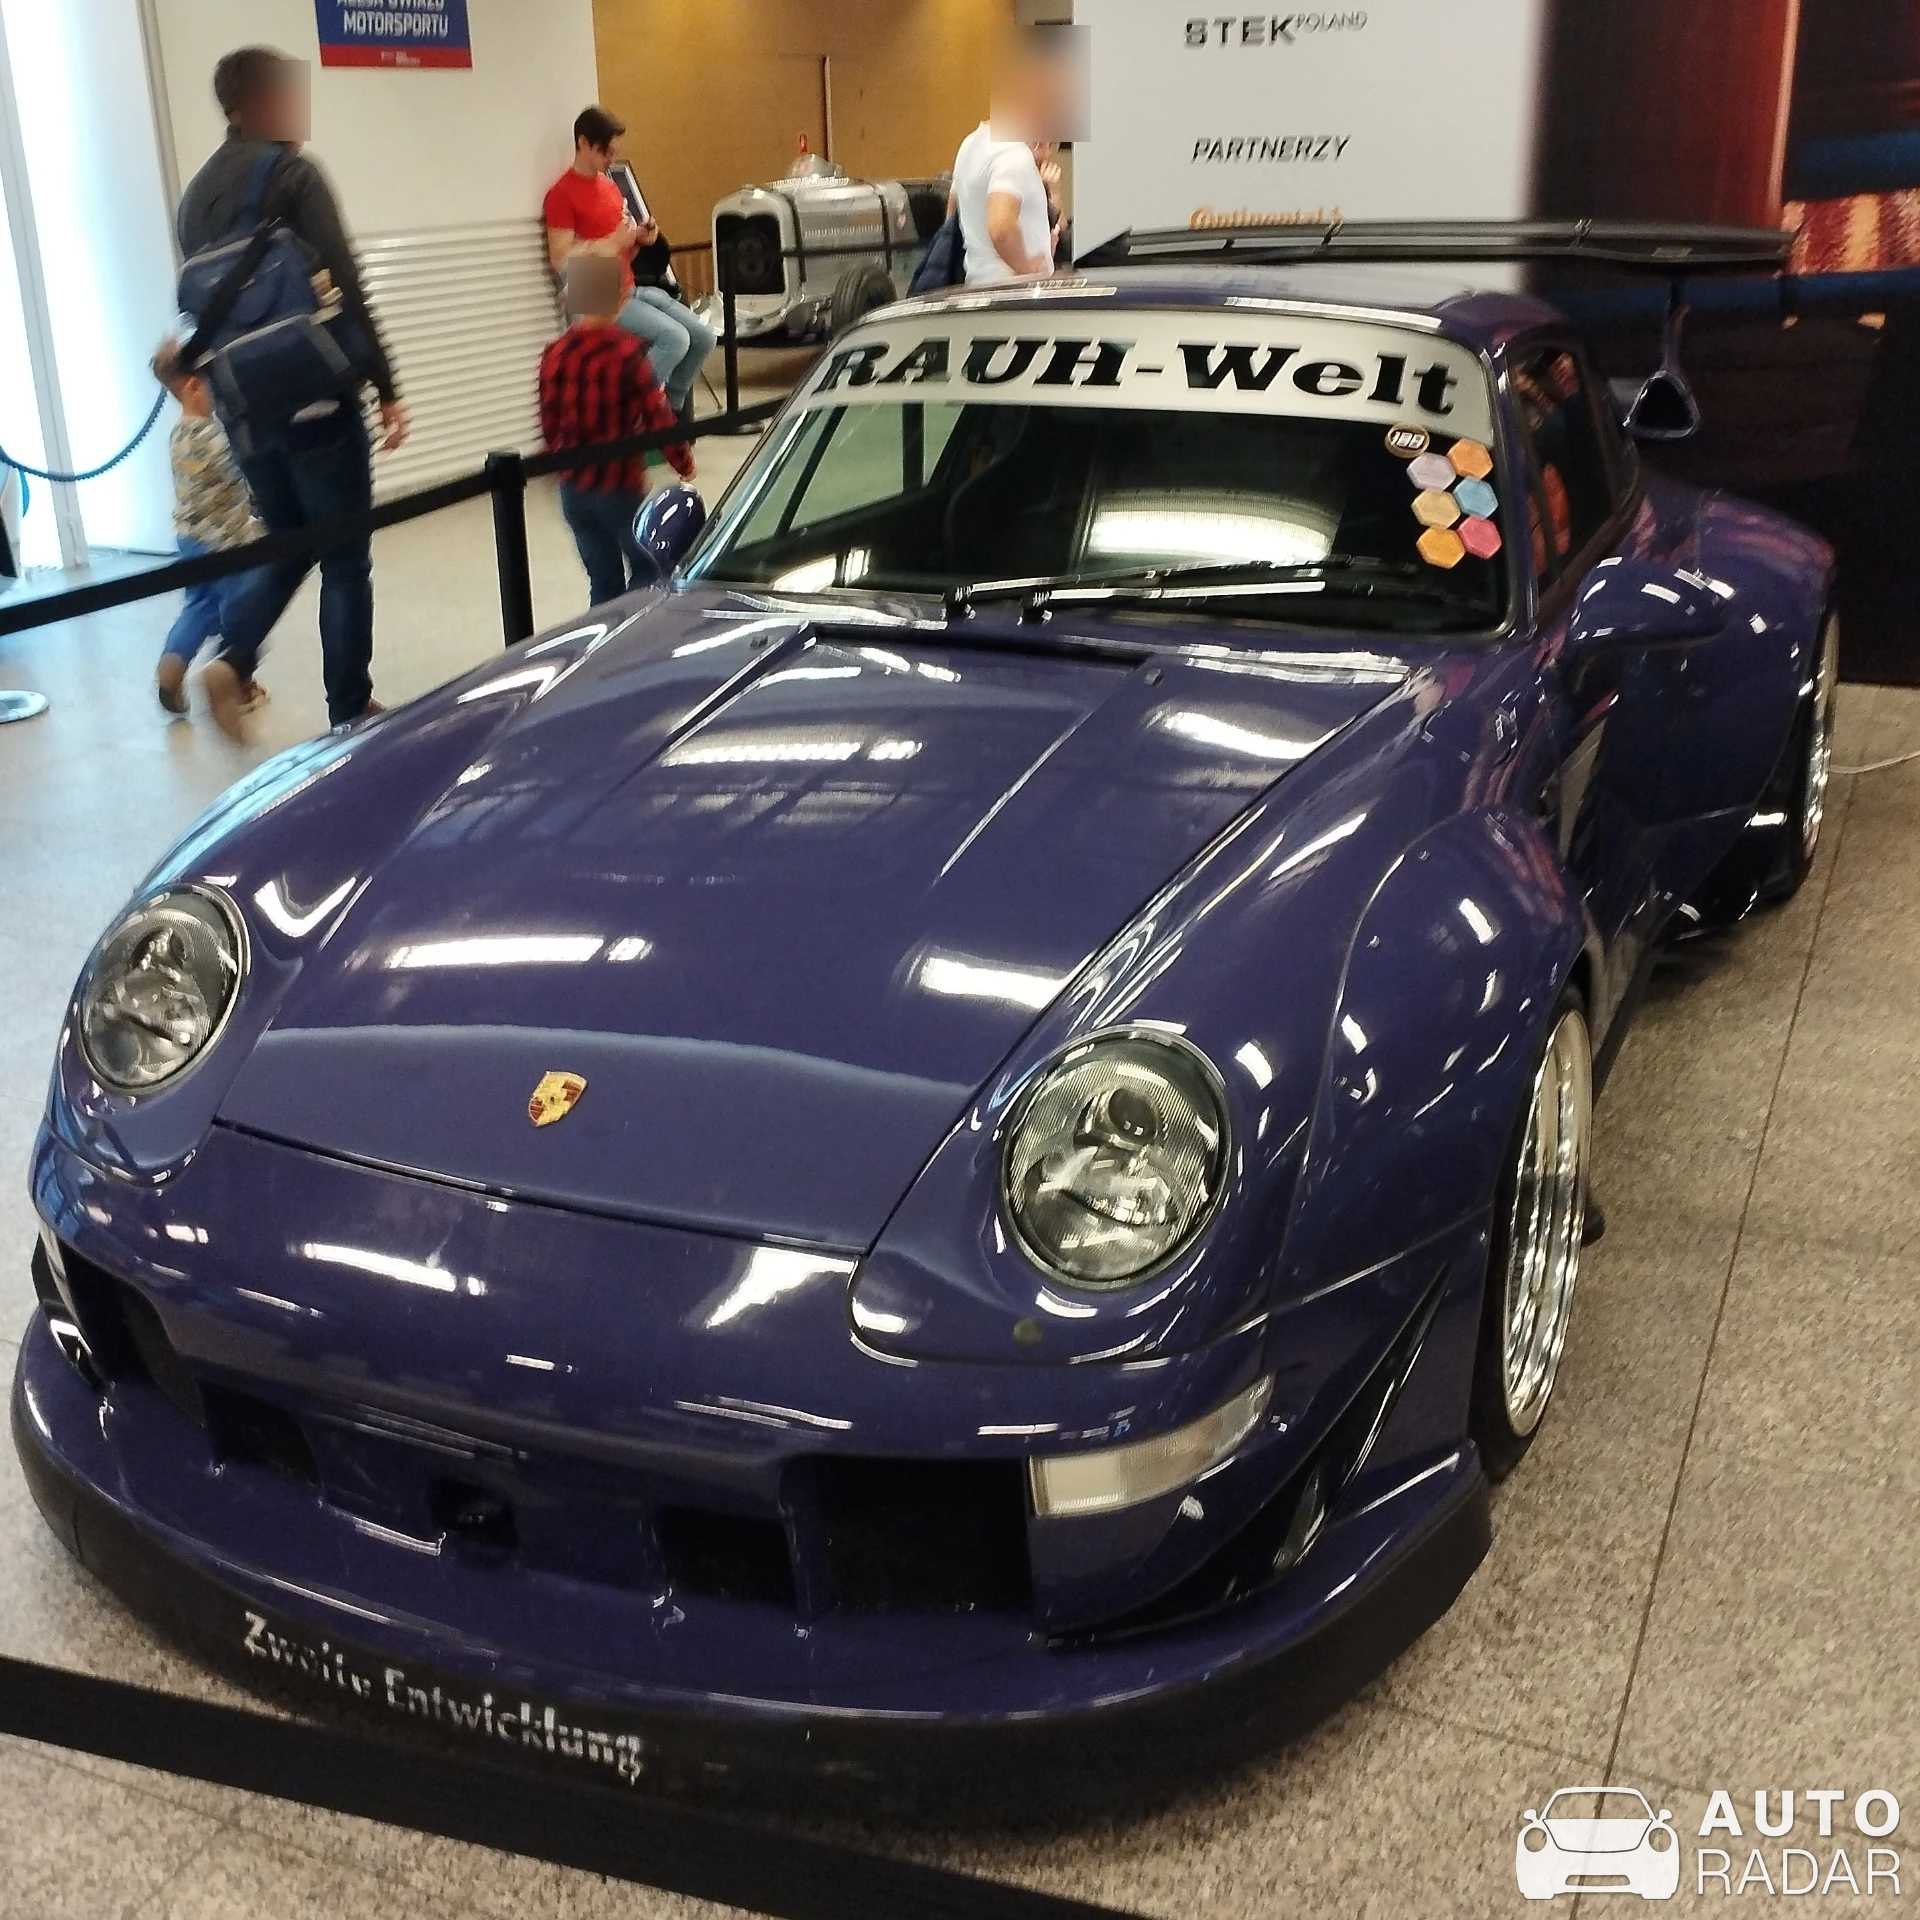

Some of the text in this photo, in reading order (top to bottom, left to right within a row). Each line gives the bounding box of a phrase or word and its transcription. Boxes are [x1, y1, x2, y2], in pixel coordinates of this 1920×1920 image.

[344, 10, 449, 38] MOTORSPORTU
[1185, 10, 1368, 48] STEK POLAND
[1191, 134, 1351, 163] PARTNERZY
[811, 336, 1460, 416] RAUH-Welt
[385, 1666, 642, 1786] Entwicklung
